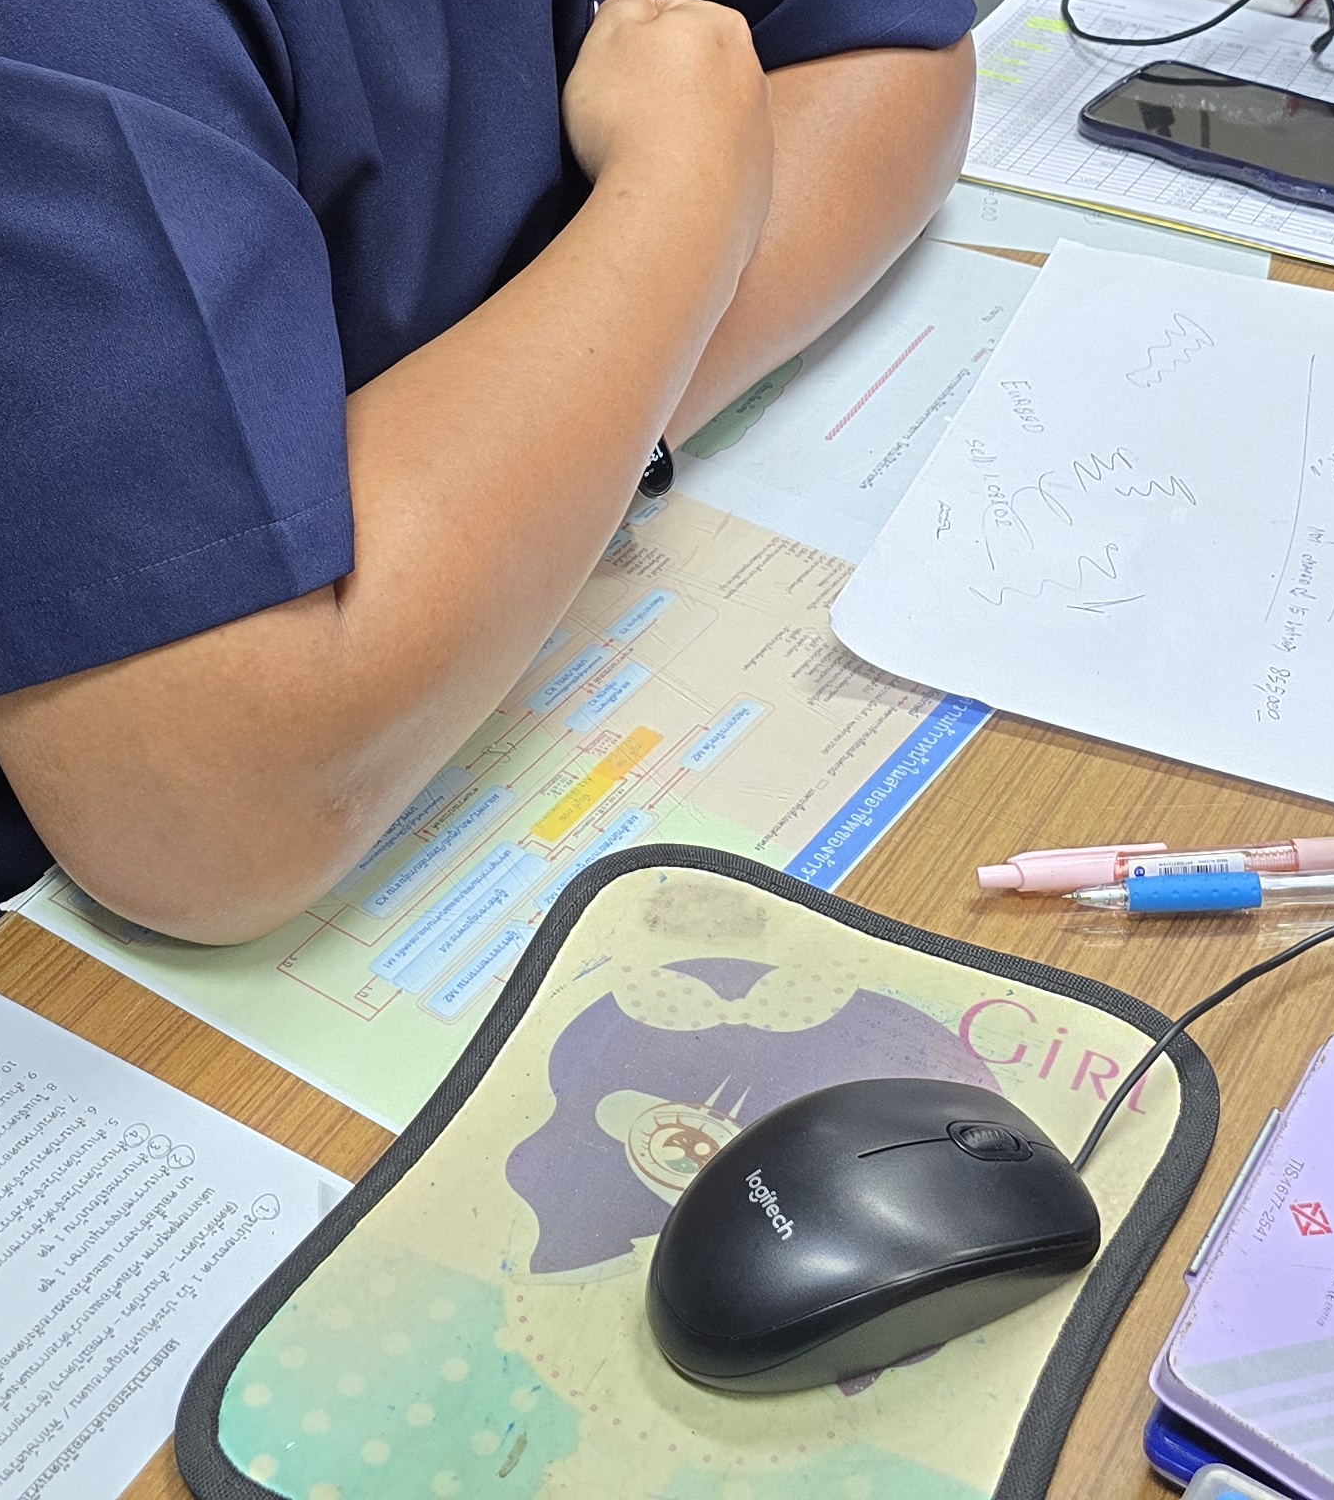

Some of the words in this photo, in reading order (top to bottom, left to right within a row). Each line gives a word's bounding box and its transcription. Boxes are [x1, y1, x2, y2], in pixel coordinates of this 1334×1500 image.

[60, 1150, 152, 1237] สำเนาทะเบียนบ้าน
[744, 1169, 795, 1241] logitech
[33, 1237, 55, 1260] ชุด
[32, 1270, 56, 1294] ชุด
